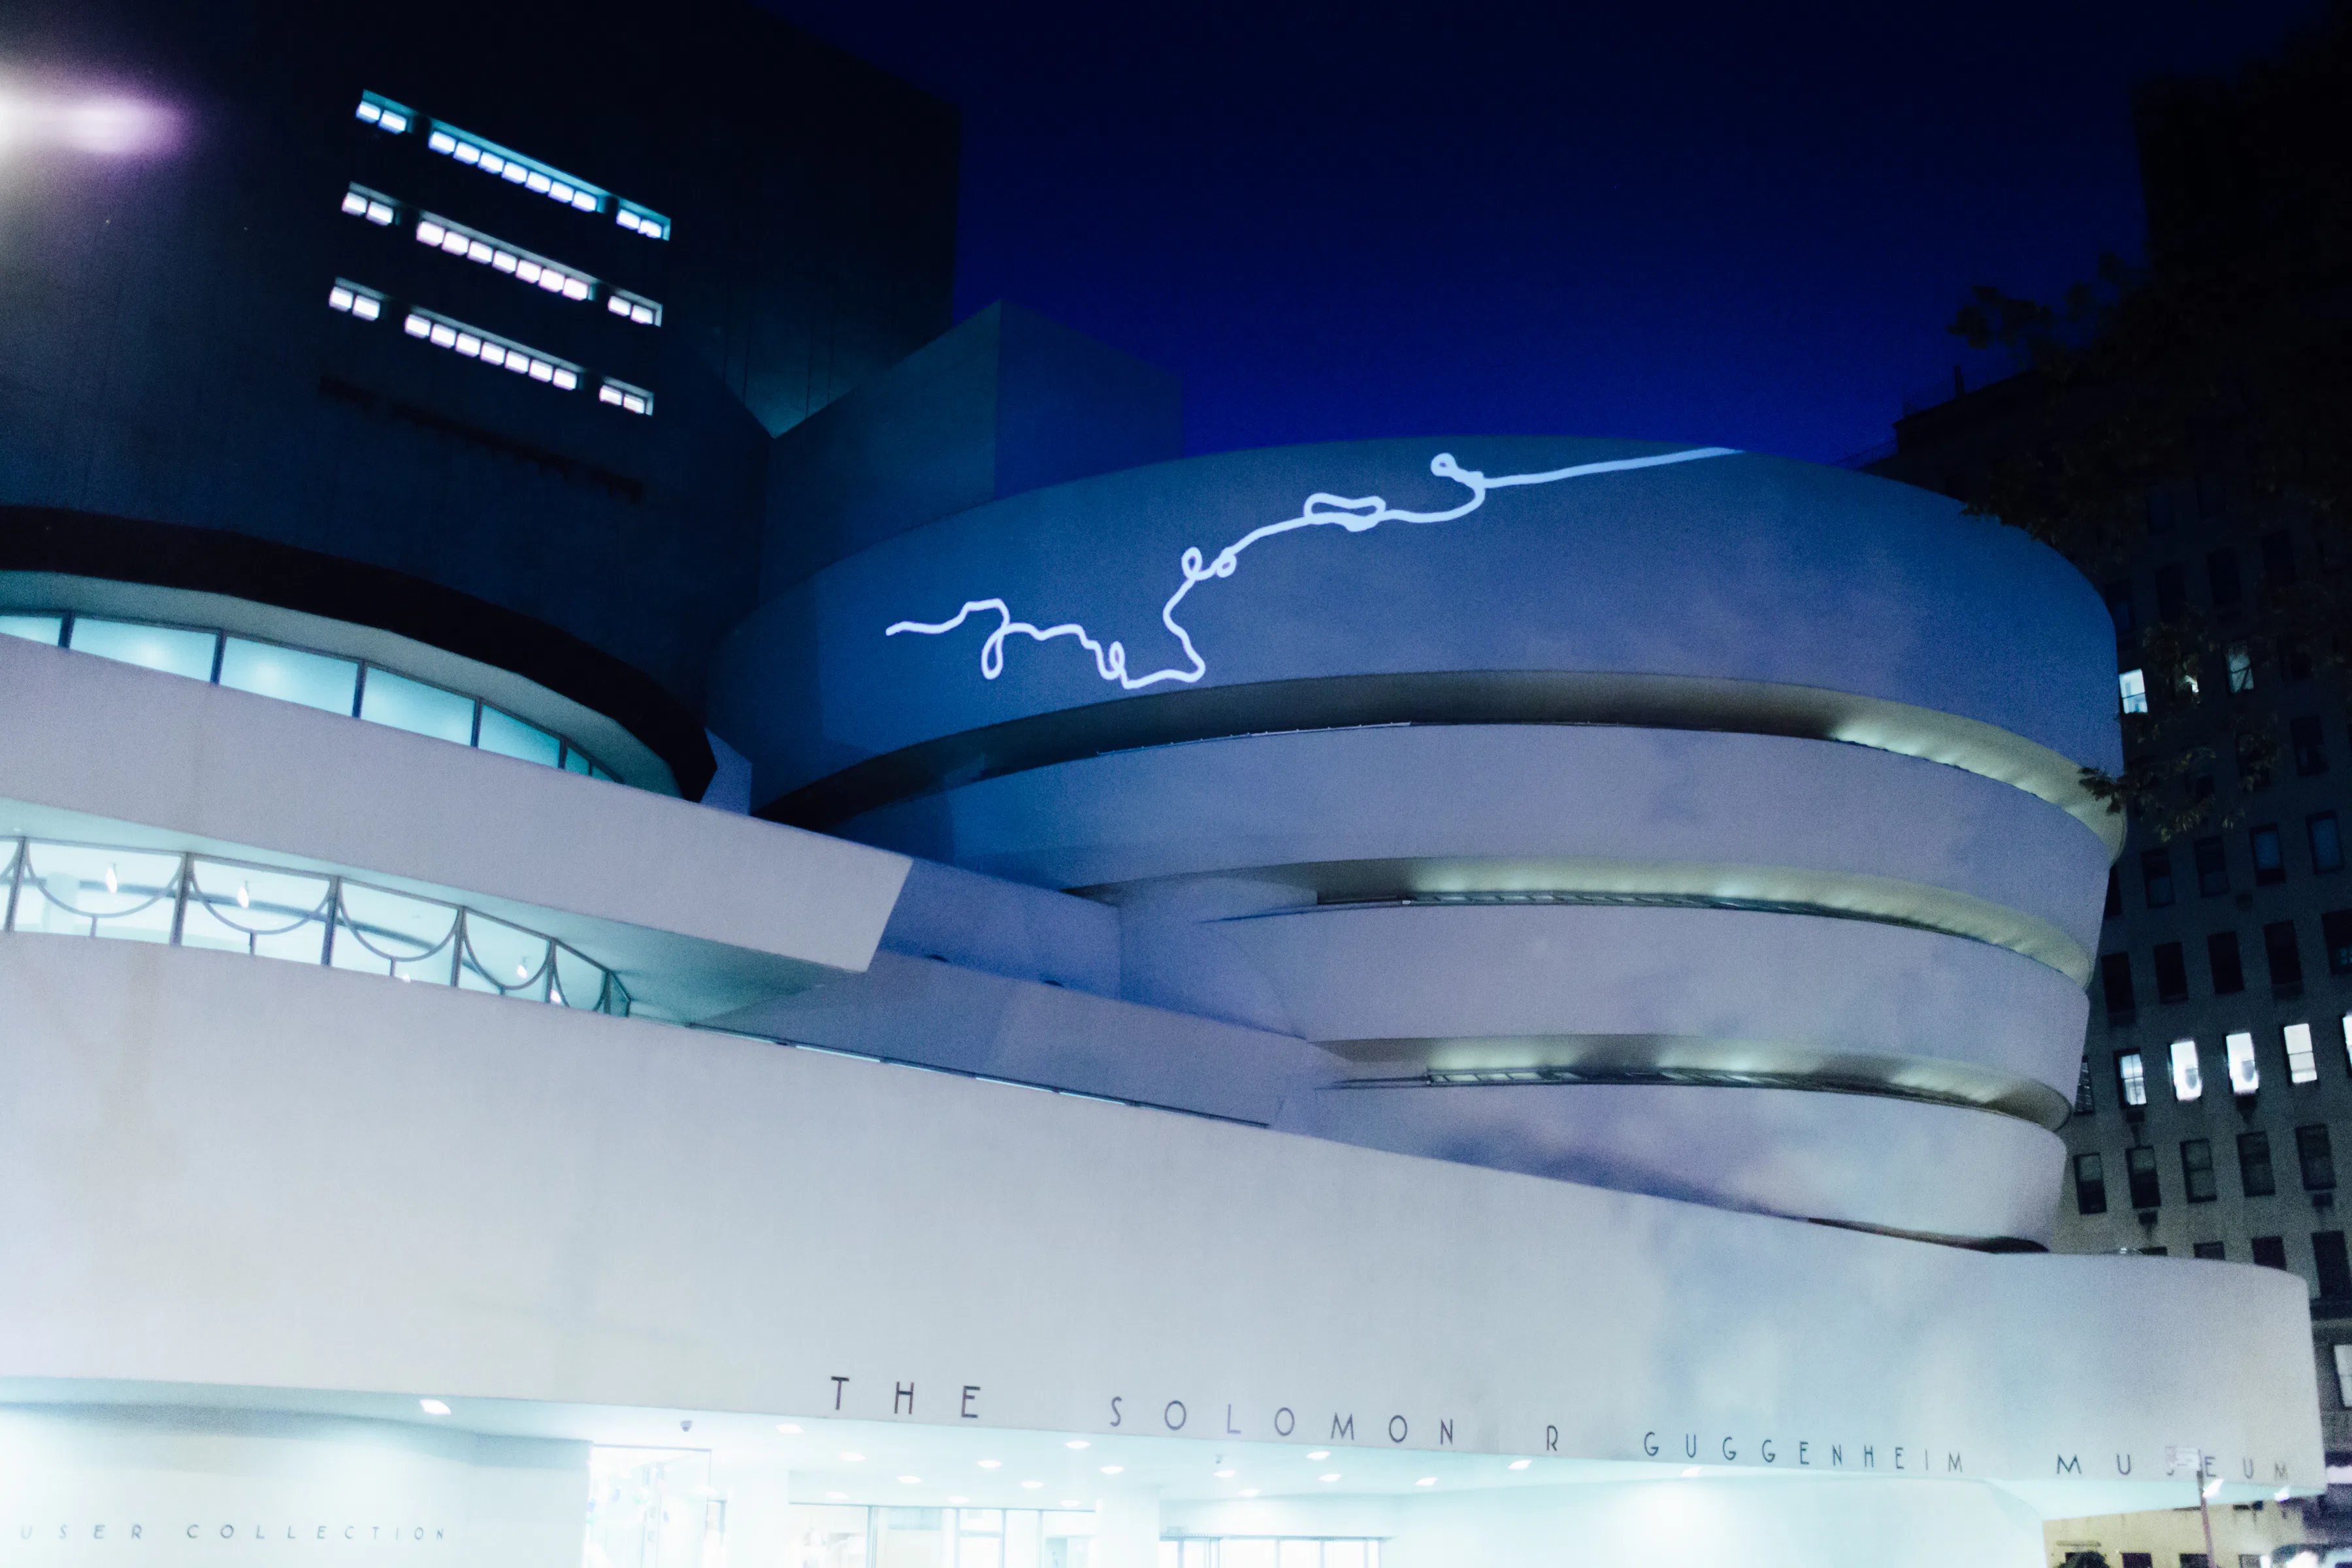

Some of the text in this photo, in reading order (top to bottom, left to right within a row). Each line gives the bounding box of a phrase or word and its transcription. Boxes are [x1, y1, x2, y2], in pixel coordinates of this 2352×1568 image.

[830, 1375, 981, 1418] THE
[1109, 1396, 1455, 1446] SOLOMON
[1546, 1424, 1558, 1452] R
[1644, 1431, 1963, 1473] GUGGENHEIM
[2056, 1453, 2289, 1481] MUEUM
[186, 1524, 446, 1541] COLLECTION
